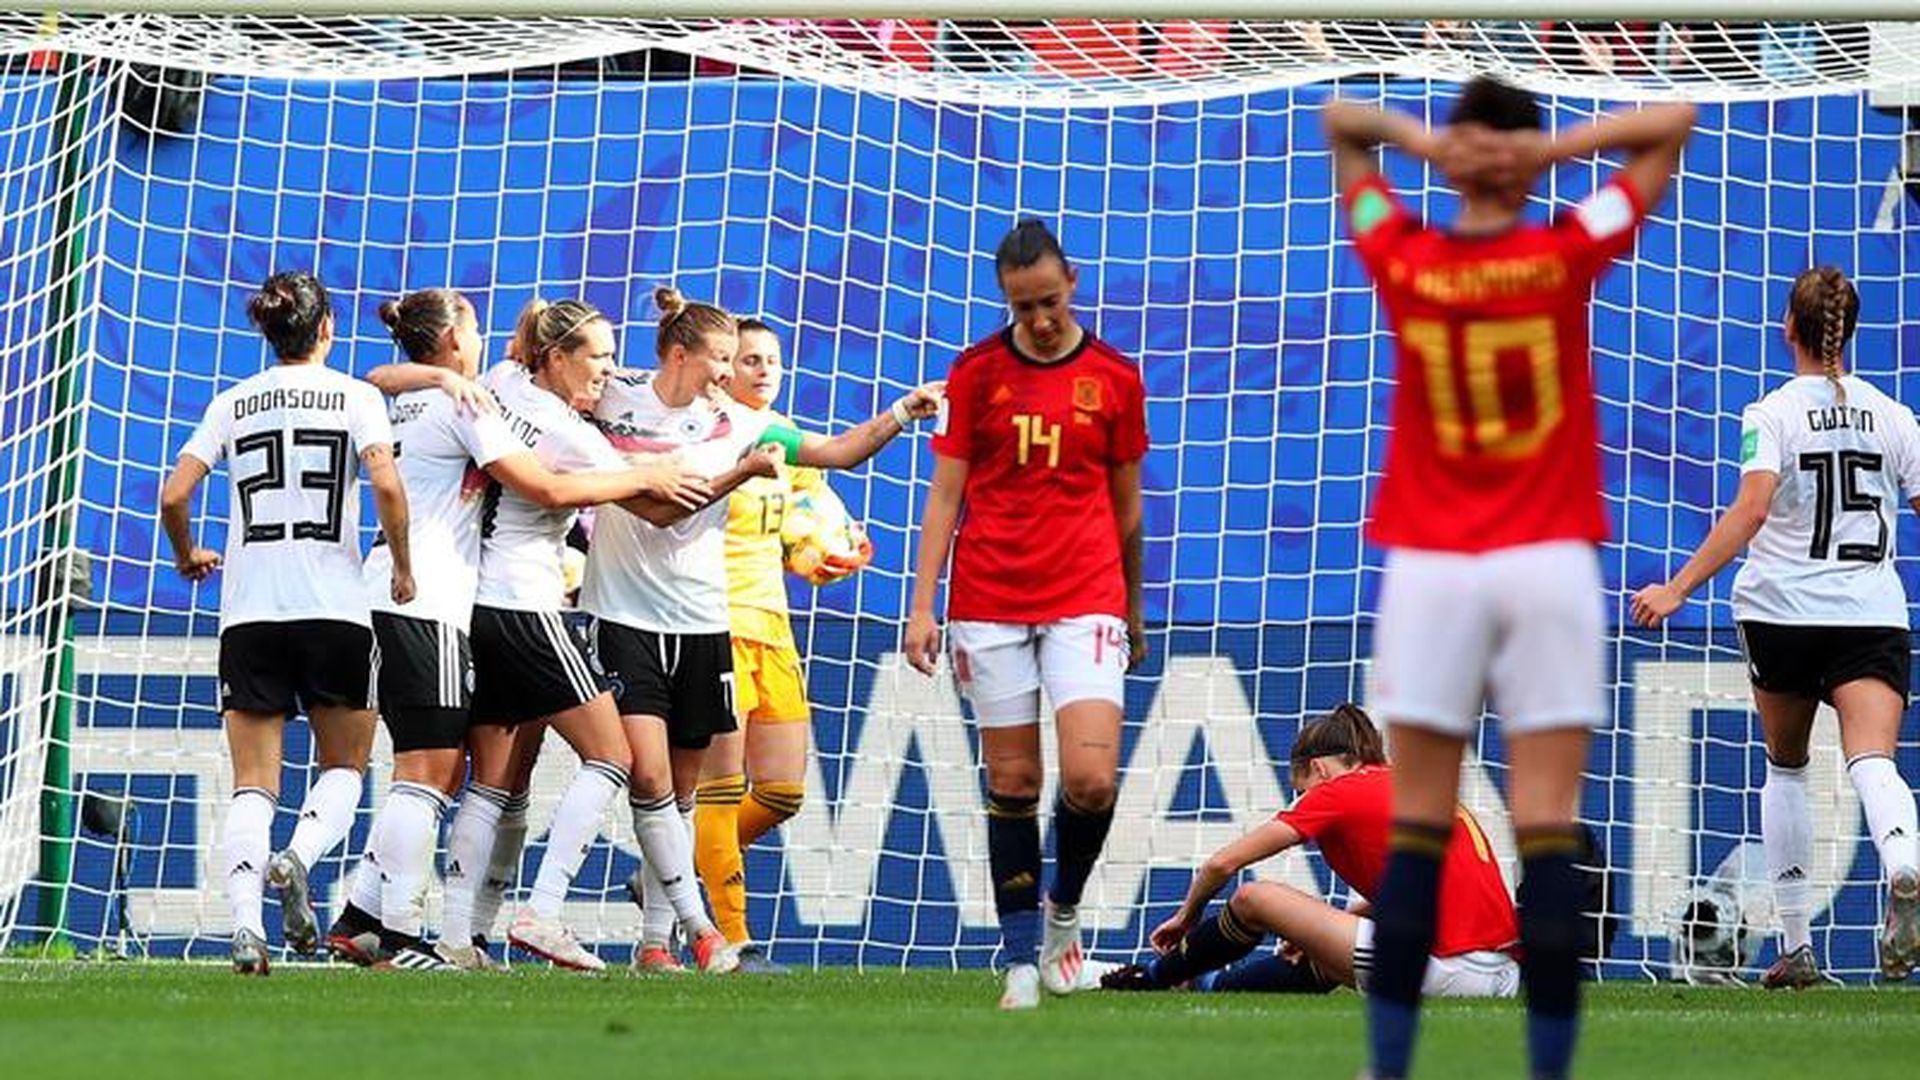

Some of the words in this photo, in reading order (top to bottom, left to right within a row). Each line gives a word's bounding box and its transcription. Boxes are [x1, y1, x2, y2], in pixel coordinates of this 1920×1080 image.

[1011, 415, 1062, 468] 14
[1402, 317, 1564, 459] 10
[235, 428, 349, 547] 23
[759, 493, 785, 535] 13
[1799, 449, 1889, 563] 15
